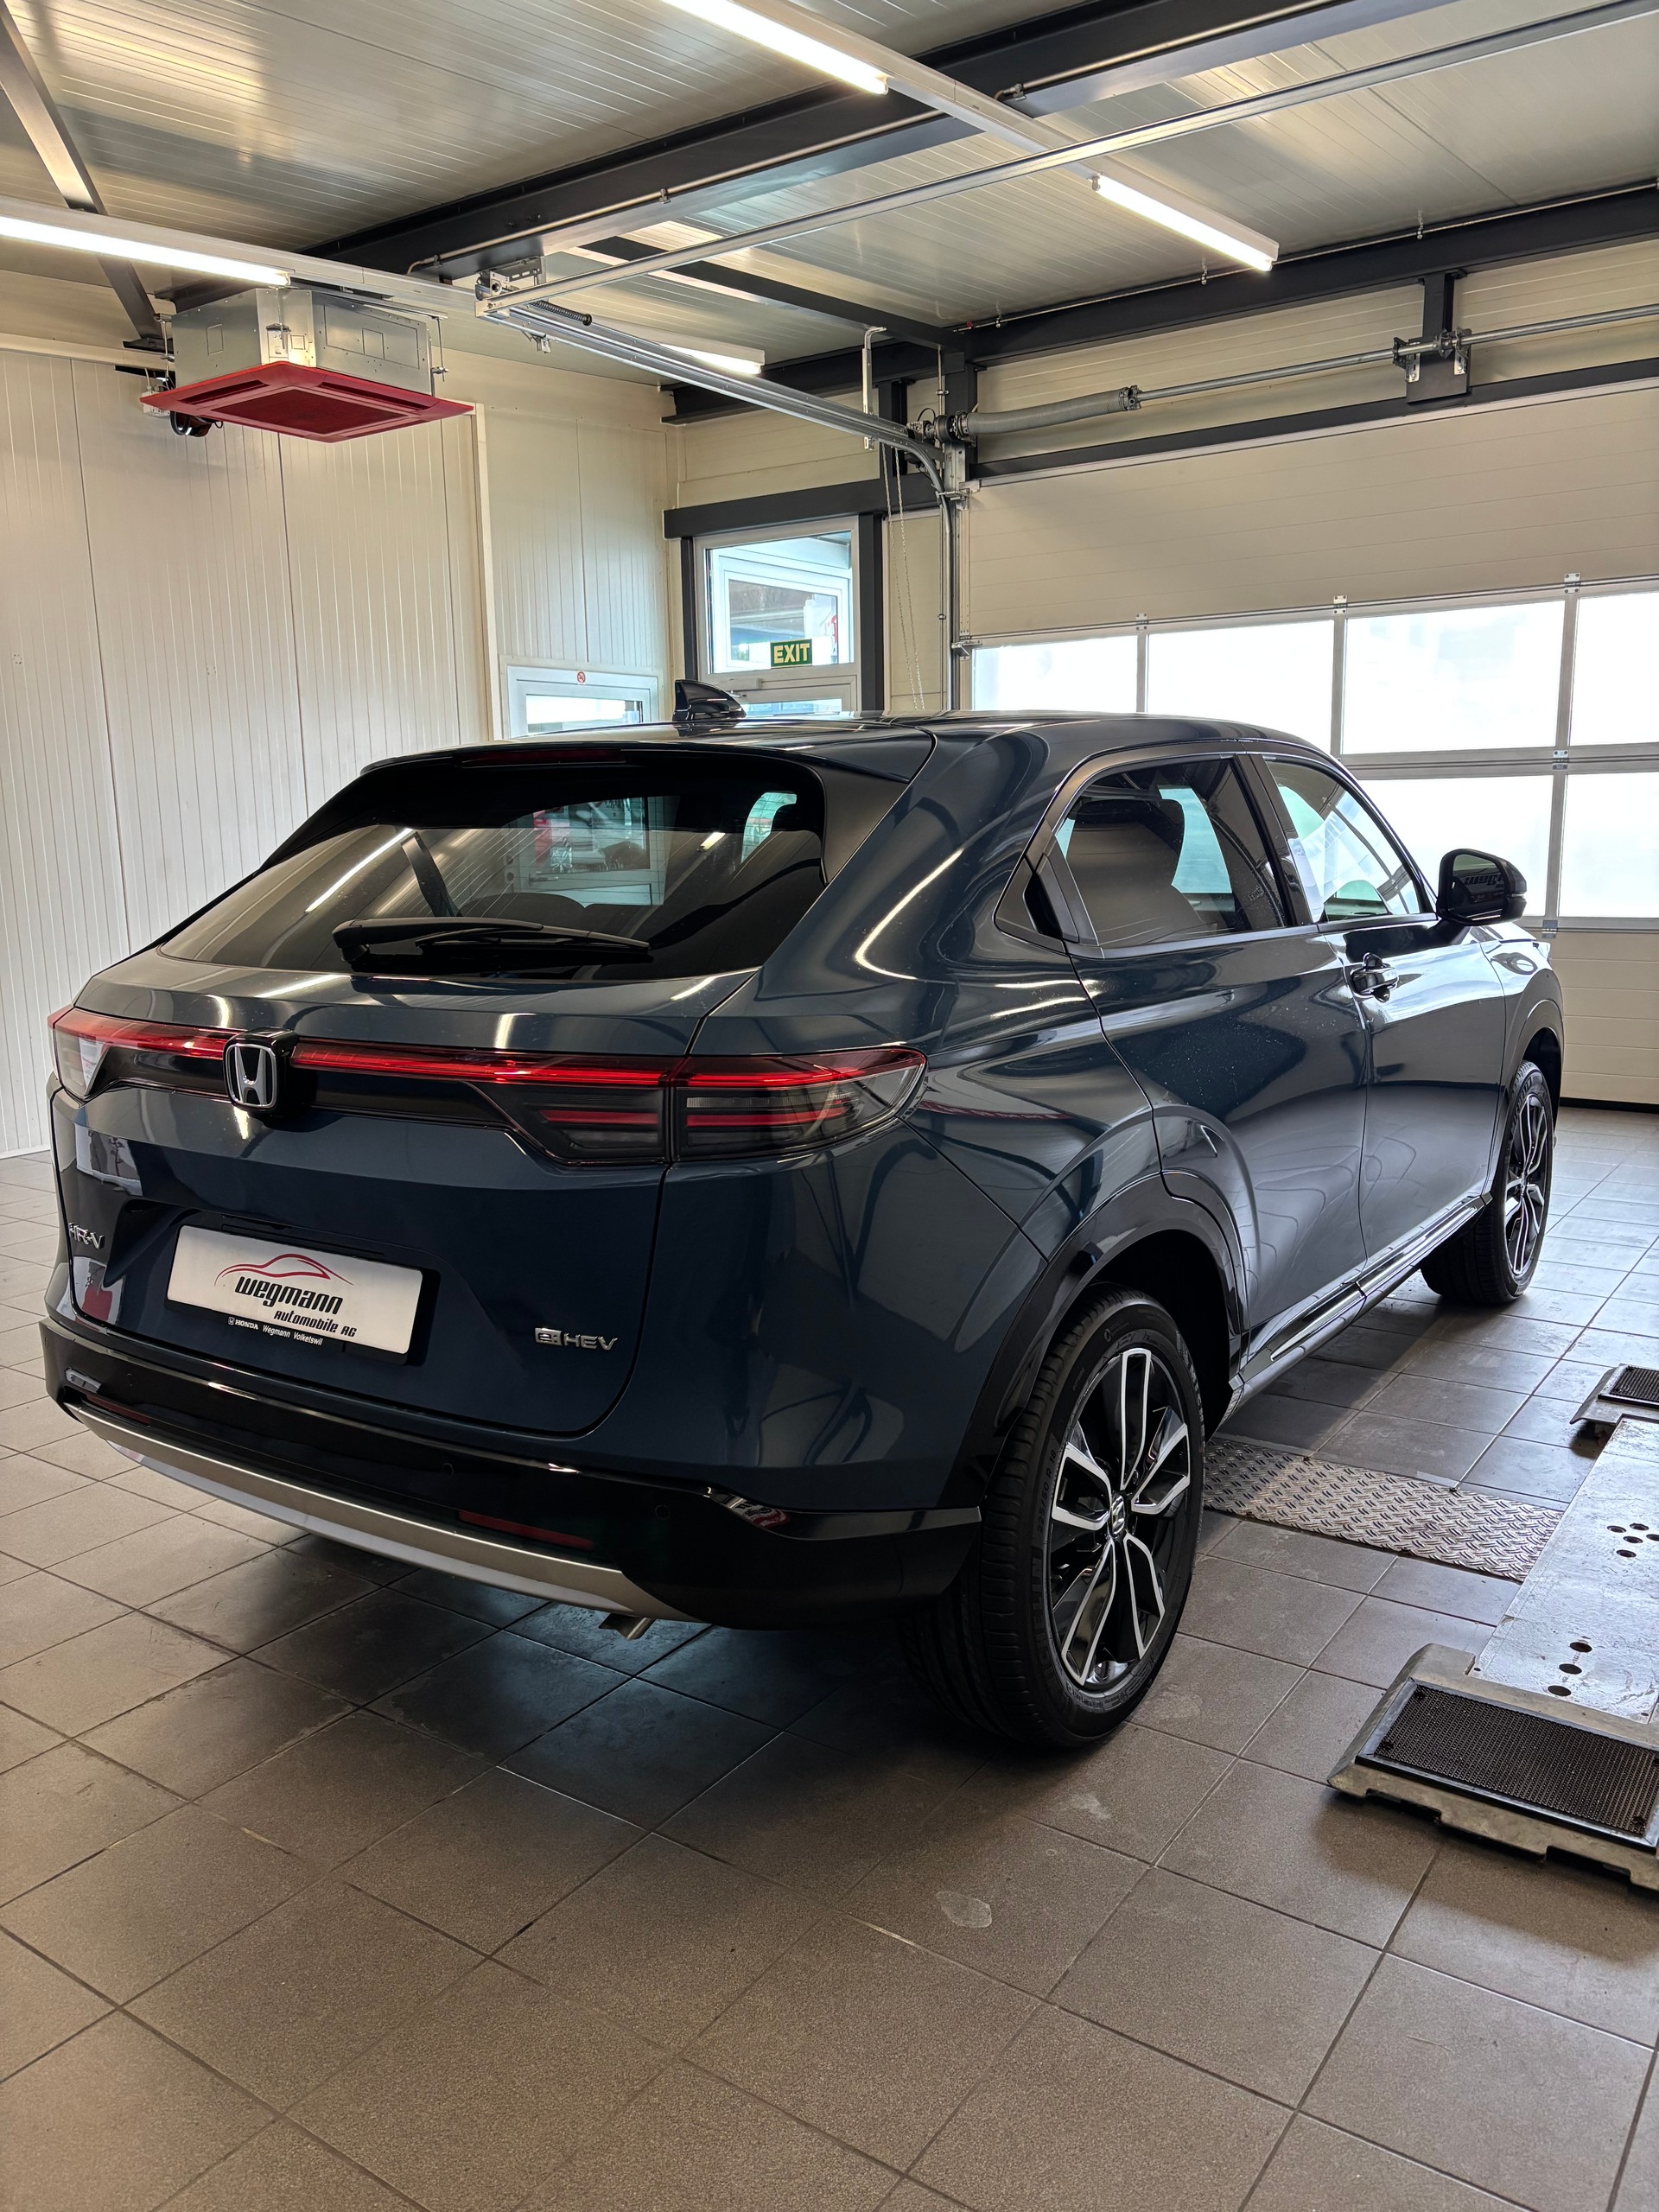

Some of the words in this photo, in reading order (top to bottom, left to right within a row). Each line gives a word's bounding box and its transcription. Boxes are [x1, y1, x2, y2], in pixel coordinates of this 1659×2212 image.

[773, 643, 810, 664] EXIT
[69, 1222, 105, 1249] HR-V
[234, 1276, 343, 1315] wegmann
[235, 1319, 259, 1330] HONDA
[262, 1325, 291, 1338] Wegmann
[293, 1332, 324, 1345] Volketswil
[340, 1325, 358, 1338] AG
[1037, 1481, 1050, 1534] 225/50
[1046, 1467, 1052, 1478] R
[1049, 1449, 1057, 1464] 18
